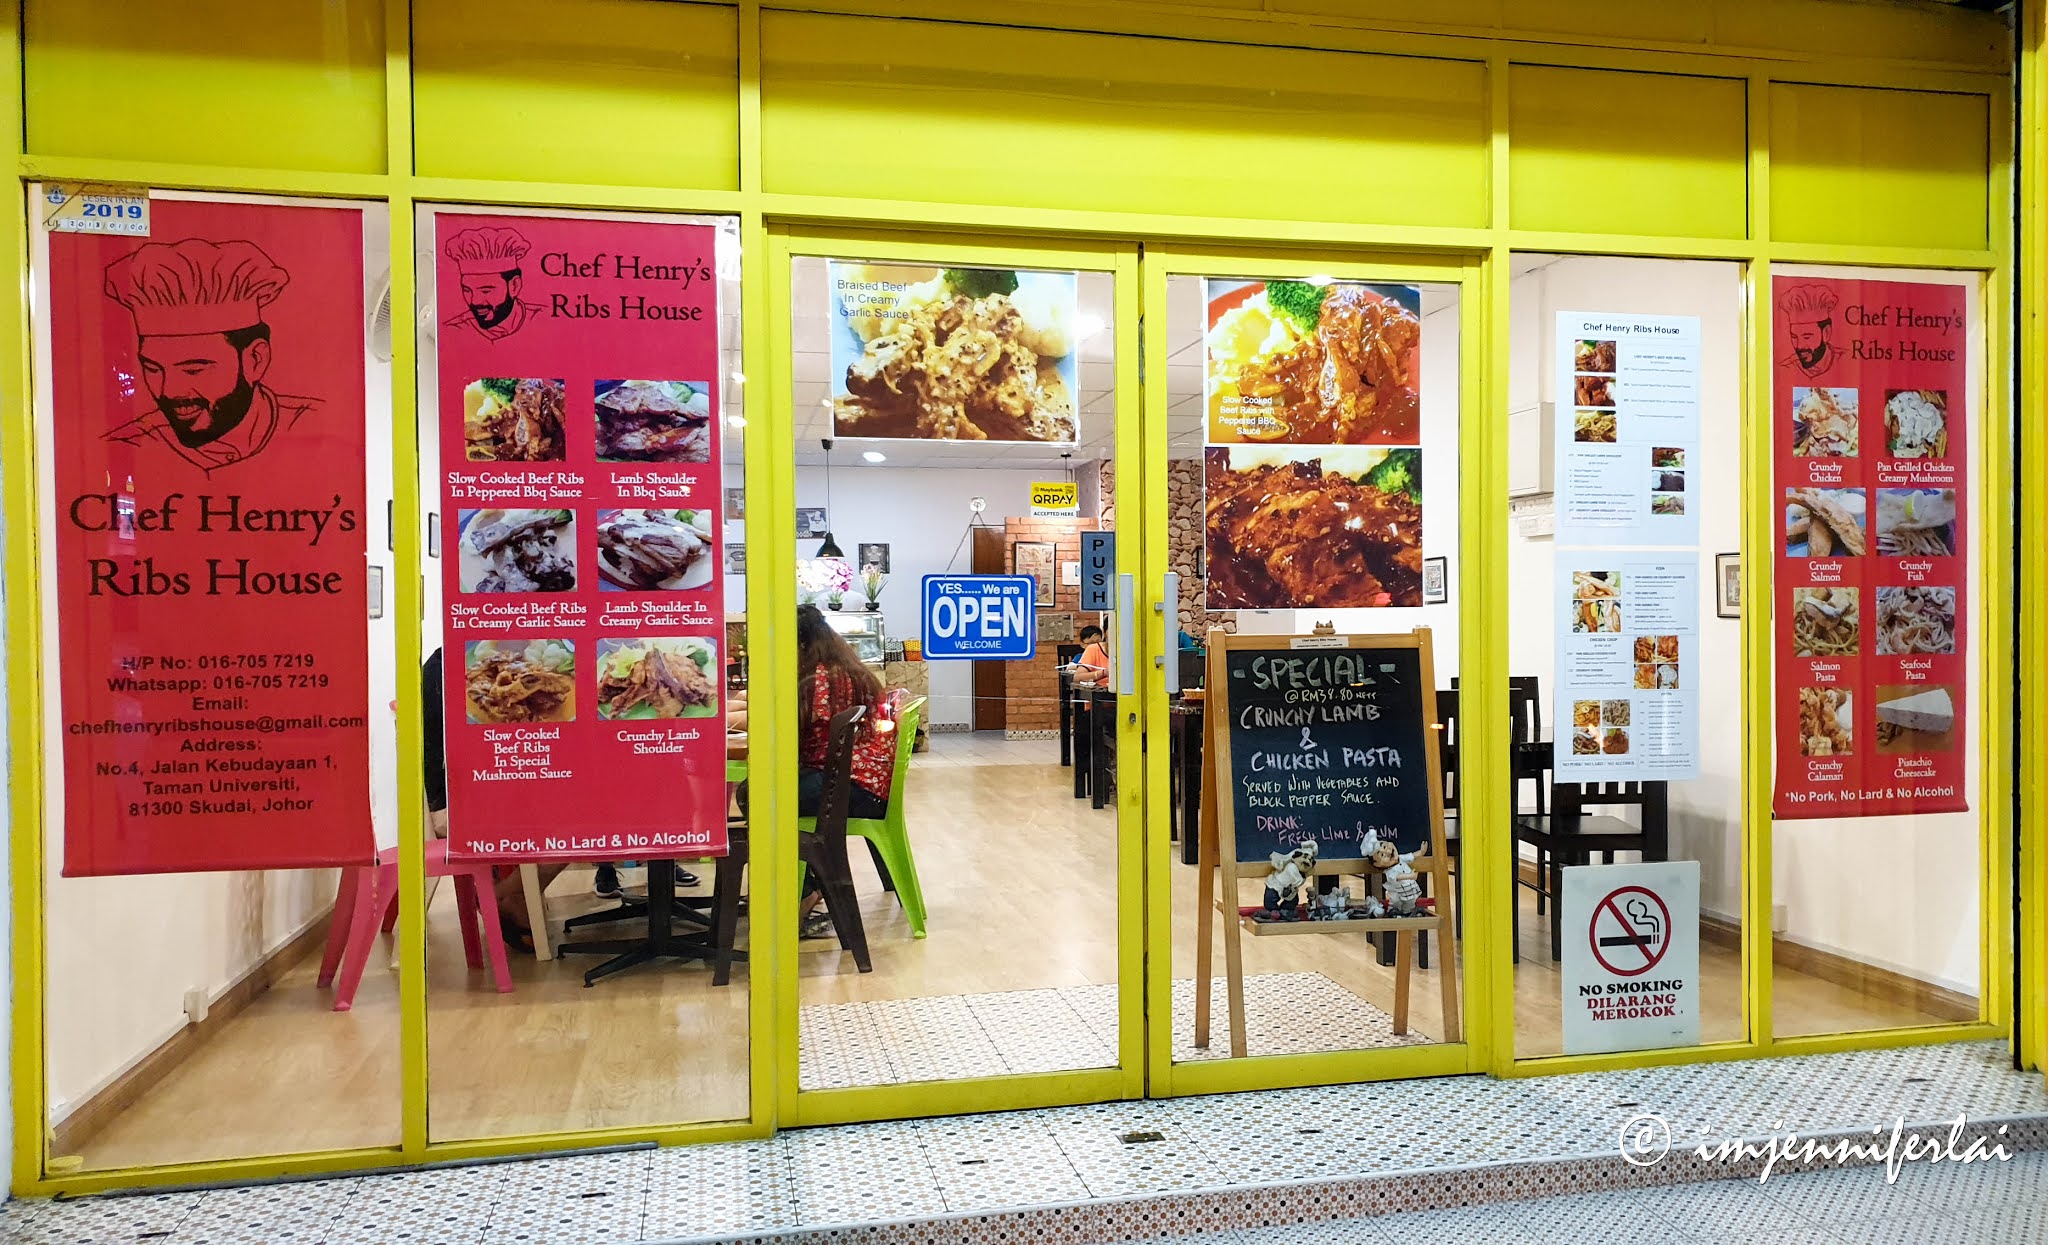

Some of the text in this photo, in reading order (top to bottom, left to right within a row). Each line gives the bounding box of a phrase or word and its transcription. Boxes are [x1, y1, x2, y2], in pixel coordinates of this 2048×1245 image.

[82, 203, 142, 218] 2019
[540, 252, 711, 290] Chef Henry's
[838, 280, 906, 292] Braised Beef
[550, 294, 703, 321] Ribs House
[845, 294, 900, 307] In Creamy
[840, 307, 908, 318] Garlic Sauce
[1845, 305, 1962, 336] Chef Henry's
[1583, 322, 1680, 334] Chef Henry Ribs House
[1851, 340, 1956, 362] Ribs House
[1219, 417, 1256, 426] Peppered
[1809, 462, 1842, 473] Crunchy
[1877, 462, 1955, 471] Pan Grilled Chicken
[448, 472, 584, 484] Slow Cooked Beef Ribs
[611, 474, 697, 485] Lamb Shoulder
[1809, 473, 1842, 482] Chicken
[1878, 474, 1954, 485] Creamy Mushroom
[451, 486, 582, 501] In Peppered Bbq Sauce
[618, 486, 691, 500] In Bbq Sauce
[1034, 495, 1073, 504] QRPAY
[70, 493, 356, 546] Chef Henry's
[1092, 539, 1105, 603] PUSH
[1809, 562, 1842, 573] Crunchy
[1899, 561, 1933, 572] Crunchy
[88, 559, 342, 596] Ribs House
[1810, 572, 1841, 581] Salmon
[1907, 572, 1924, 581] Fish
[982, 584, 1000, 594] We
[1003, 586, 1020, 594] are
[451, 602, 587, 615] Slow Cooked Beef Ribs
[606, 601, 708, 614] Lamb Shoulder In
[452, 616, 586, 632] In Creamy Garlic Sauce
[600, 614, 713, 630] Creamy Garlic Sauce
[932, 596, 1024, 638] OPEN
[955, 640, 1002, 649] WELCOME
[122, 655, 314, 671] H/P No: 016-705 7219
[1810, 662, 1841, 671] Salmon
[1900, 660, 1932, 669] Seafood
[1252, 654, 1376, 689] SPECIAL
[1815, 672, 1836, 682] Pasta
[1905, 671, 1926, 680] Pasta
[107, 674, 328, 694] Whatsapp: 016-705 7219
[192, 696, 248, 711] Email:
[1240, 703, 1381, 729] CRUNCHY LAMB
[69, 715, 363, 736] chefhenryribshouse@gmail.com
[484, 729, 560, 740] Slow Cooked
[617, 729, 700, 745] Crunchy Lamb
[1300, 727, 1317, 750] &
[180, 738, 262, 753] Address:
[494, 742, 550, 754] Beef Ribs
[633, 742, 684, 754] Shoulder
[96, 756, 316, 776] No.4, Jalan Kebudayaan
[494, 755, 551, 769] In Special
[1251, 747, 1401, 772] CHICKEN PASTA
[1808, 761, 1843, 772] Crunchy
[1898, 757, 1932, 767] Pistachio
[473, 768, 573, 781] Mushroom Sauce
[1808, 772, 1843, 781] Calamari
[1894, 768, 1936, 778] Cheesecake
[144, 778, 300, 796] Taman Universiti,
[1316, 776, 1369, 789] VEGETABLES
[1376, 777, 1400, 788] AND
[1250, 796, 1285, 808] BLACK
[1289, 794, 1330, 808] PEPPER
[1809, 786, 1954, 803] Pork, No Lard No Alcohol
[129, 798, 314, 815] 81300 Skudai, Johor
[1256, 815, 1303, 831] DRINK:
[500, 831, 710, 853] Pork, No Lard No Alcohol
[1278, 830, 1316, 847] FRESH
[1579, 980, 1683, 996] NO SMOKING
[1587, 994, 1676, 1010] DILARANG
[1592, 1006, 1676, 1021] MEROKOK
